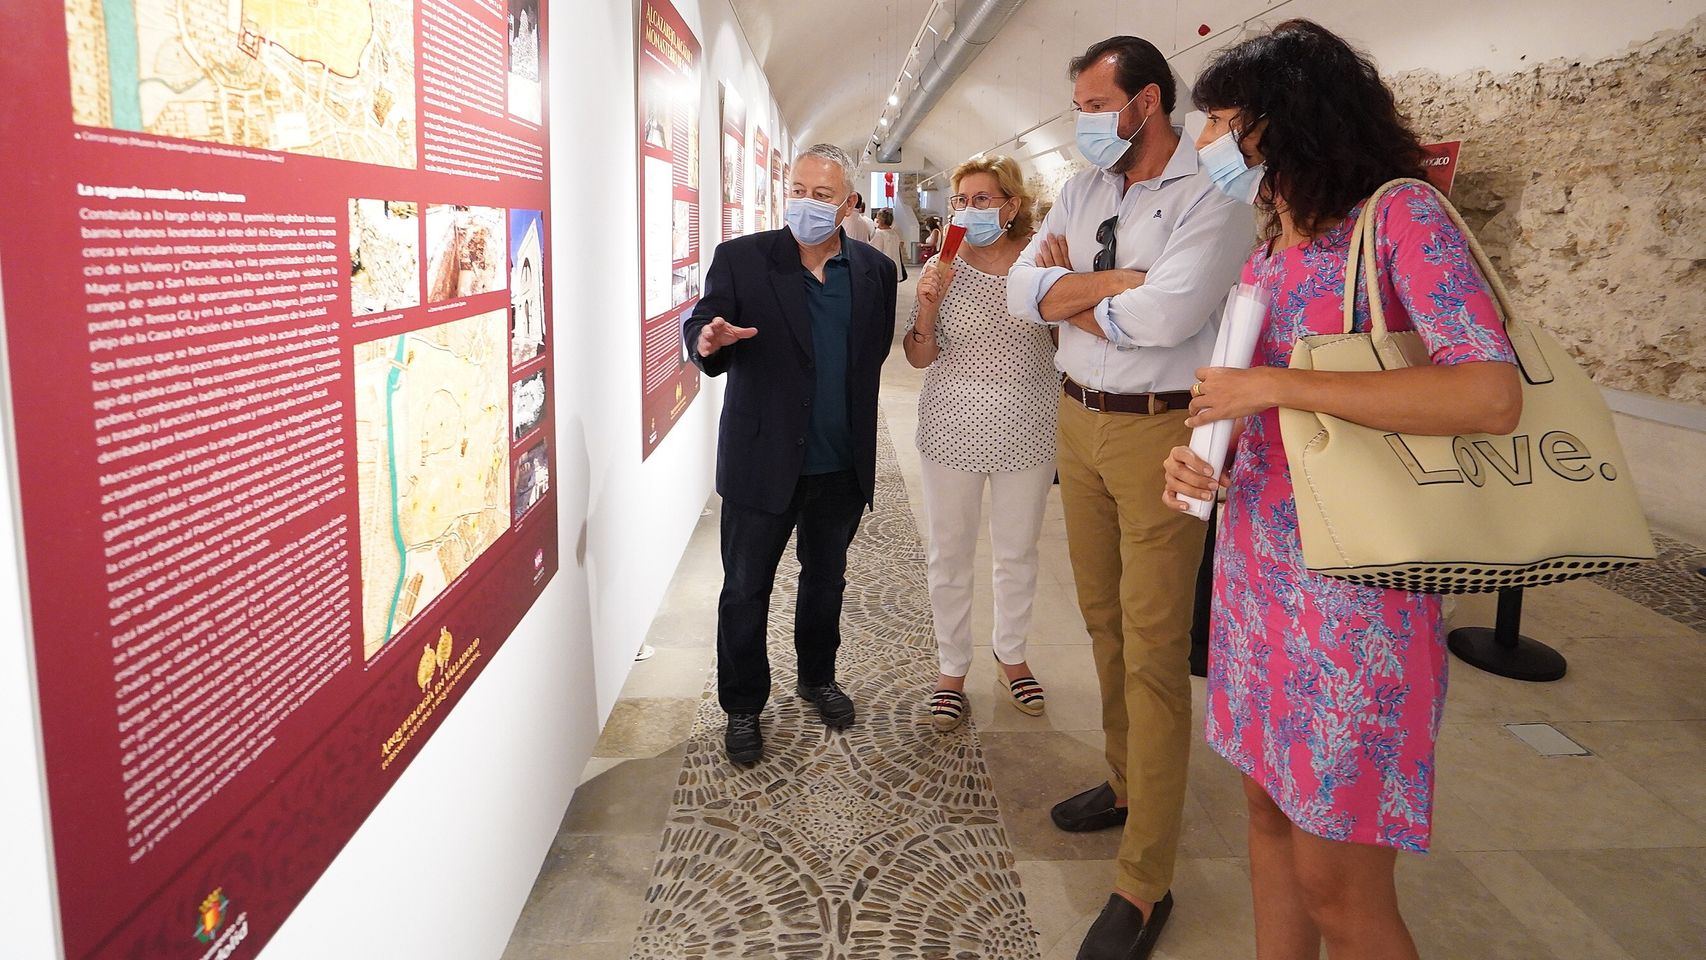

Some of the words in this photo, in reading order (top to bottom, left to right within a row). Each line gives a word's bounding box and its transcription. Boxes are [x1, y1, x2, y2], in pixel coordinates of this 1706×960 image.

[142, 211, 150, 220] a
[152, 209, 162, 220] lo
[164, 209, 189, 223] largo
[190, 211, 205, 221] del
[206, 212, 227, 223] siglo
[122, 227, 166, 238] urbanos
[216, 227, 225, 237] al
[226, 228, 243, 237] este
[244, 227, 257, 236] del
[115, 247, 128, 256] se
[105, 264, 121, 274] de
[173, 262, 180, 273] y
[235, 259, 246, 267] en
[125, 280, 154, 293] junto
[156, 280, 163, 289] a
[164, 277, 184, 288] San
[220, 273, 233, 283] en
[233, 273, 242, 282] la
[264, 271, 274, 280] de
[86, 300, 126, 312] rampa
[128, 298, 144, 308] de
[146, 294, 177, 306] salida
[178, 292, 195, 303] del
[127, 316, 144, 326] de
[193, 310, 199, 320] y
[200, 308, 213, 317] en
[214, 306, 223, 315] la
[119, 334, 134, 345] de
[135, 332, 147, 342] la
[147, 330, 171, 341] Casa
[172, 327, 185, 337] de
[220, 321, 232, 330] de
[290, 311, 298, 319] de
[153, 351, 174, 362] que
[174, 349, 186, 358] se
[187, 346, 206, 355] han
[269, 332, 276, 340] la
[110, 376, 132, 388] que
[132, 373, 145, 383] se
[190, 360, 212, 373] poco
[230, 354, 241, 364] de
[274, 345, 284, 354] de
[116, 393, 131, 404] de
[1383, 430, 1617, 488] Love.
